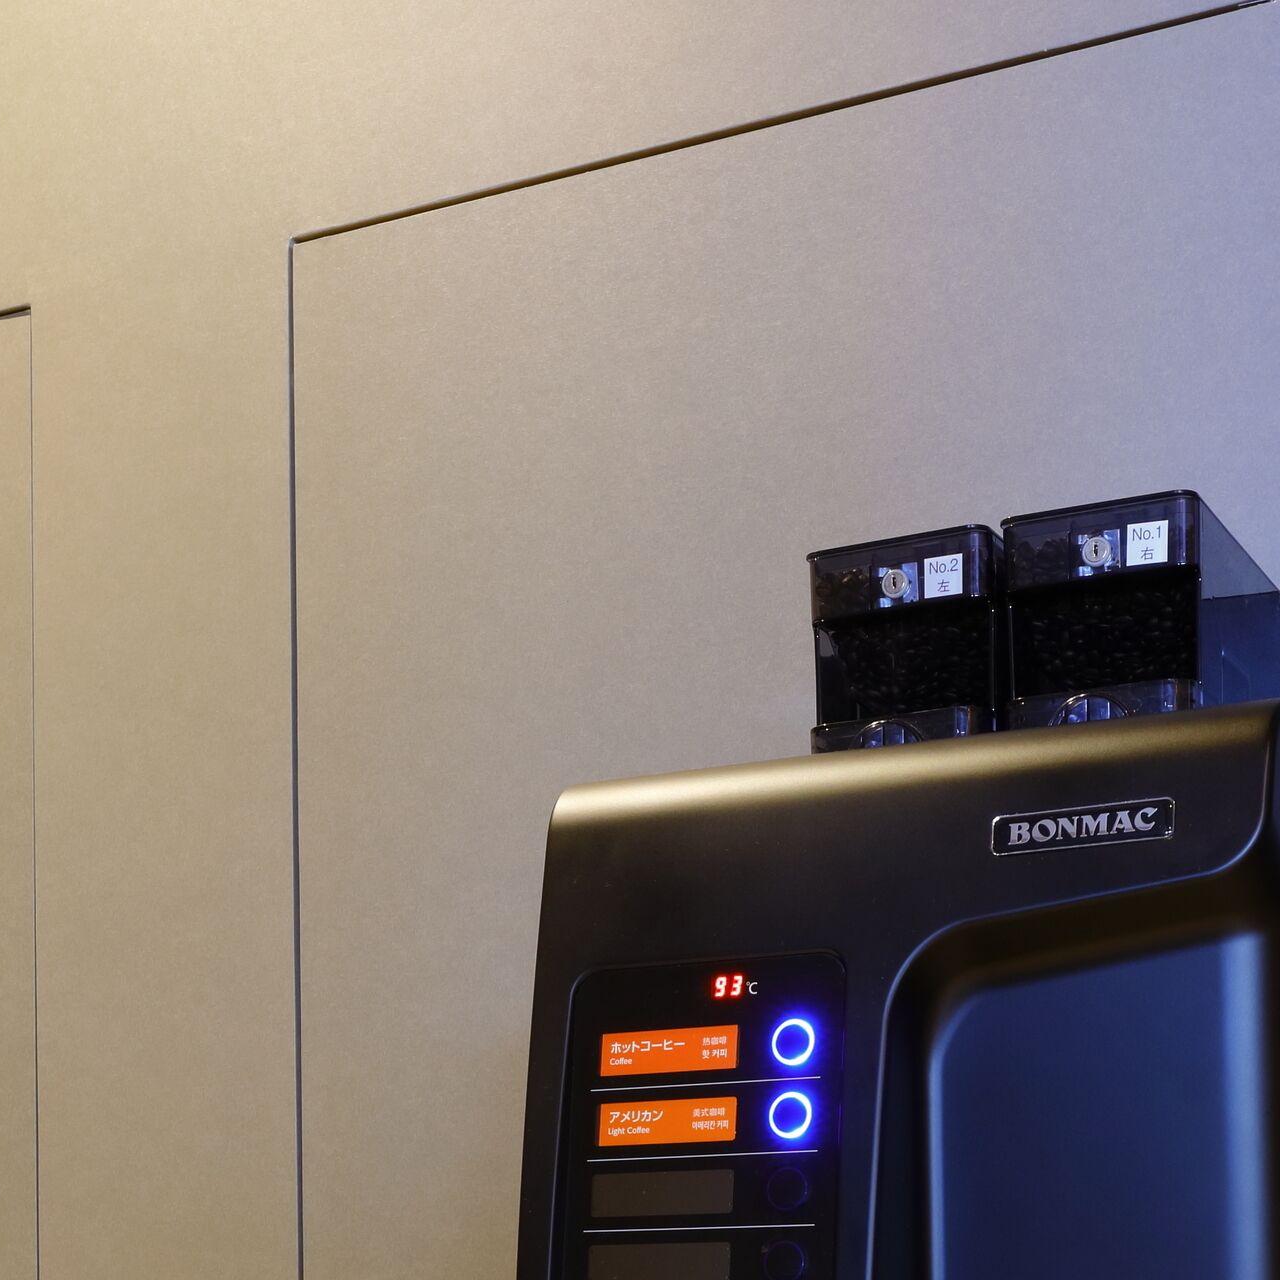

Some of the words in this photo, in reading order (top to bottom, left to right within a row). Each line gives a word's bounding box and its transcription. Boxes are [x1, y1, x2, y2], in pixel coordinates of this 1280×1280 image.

[1132, 525, 1162, 541] No.1
[1140, 546, 1154, 560] 右
[928, 558, 959, 574] No.2
[937, 578, 950, 593] 左
[1007, 806, 1158, 846] BONMAC
[714, 975, 743, 997] 93
[610, 1039, 686, 1054] ホットコーヒー
[711, 1048, 727, 1058] 커피
[609, 1057, 633, 1066] Coffee
[609, 1110, 664, 1124] アメリカン
[607, 1127, 625, 1137] Light
[626, 1126, 651, 1135] Coffee
